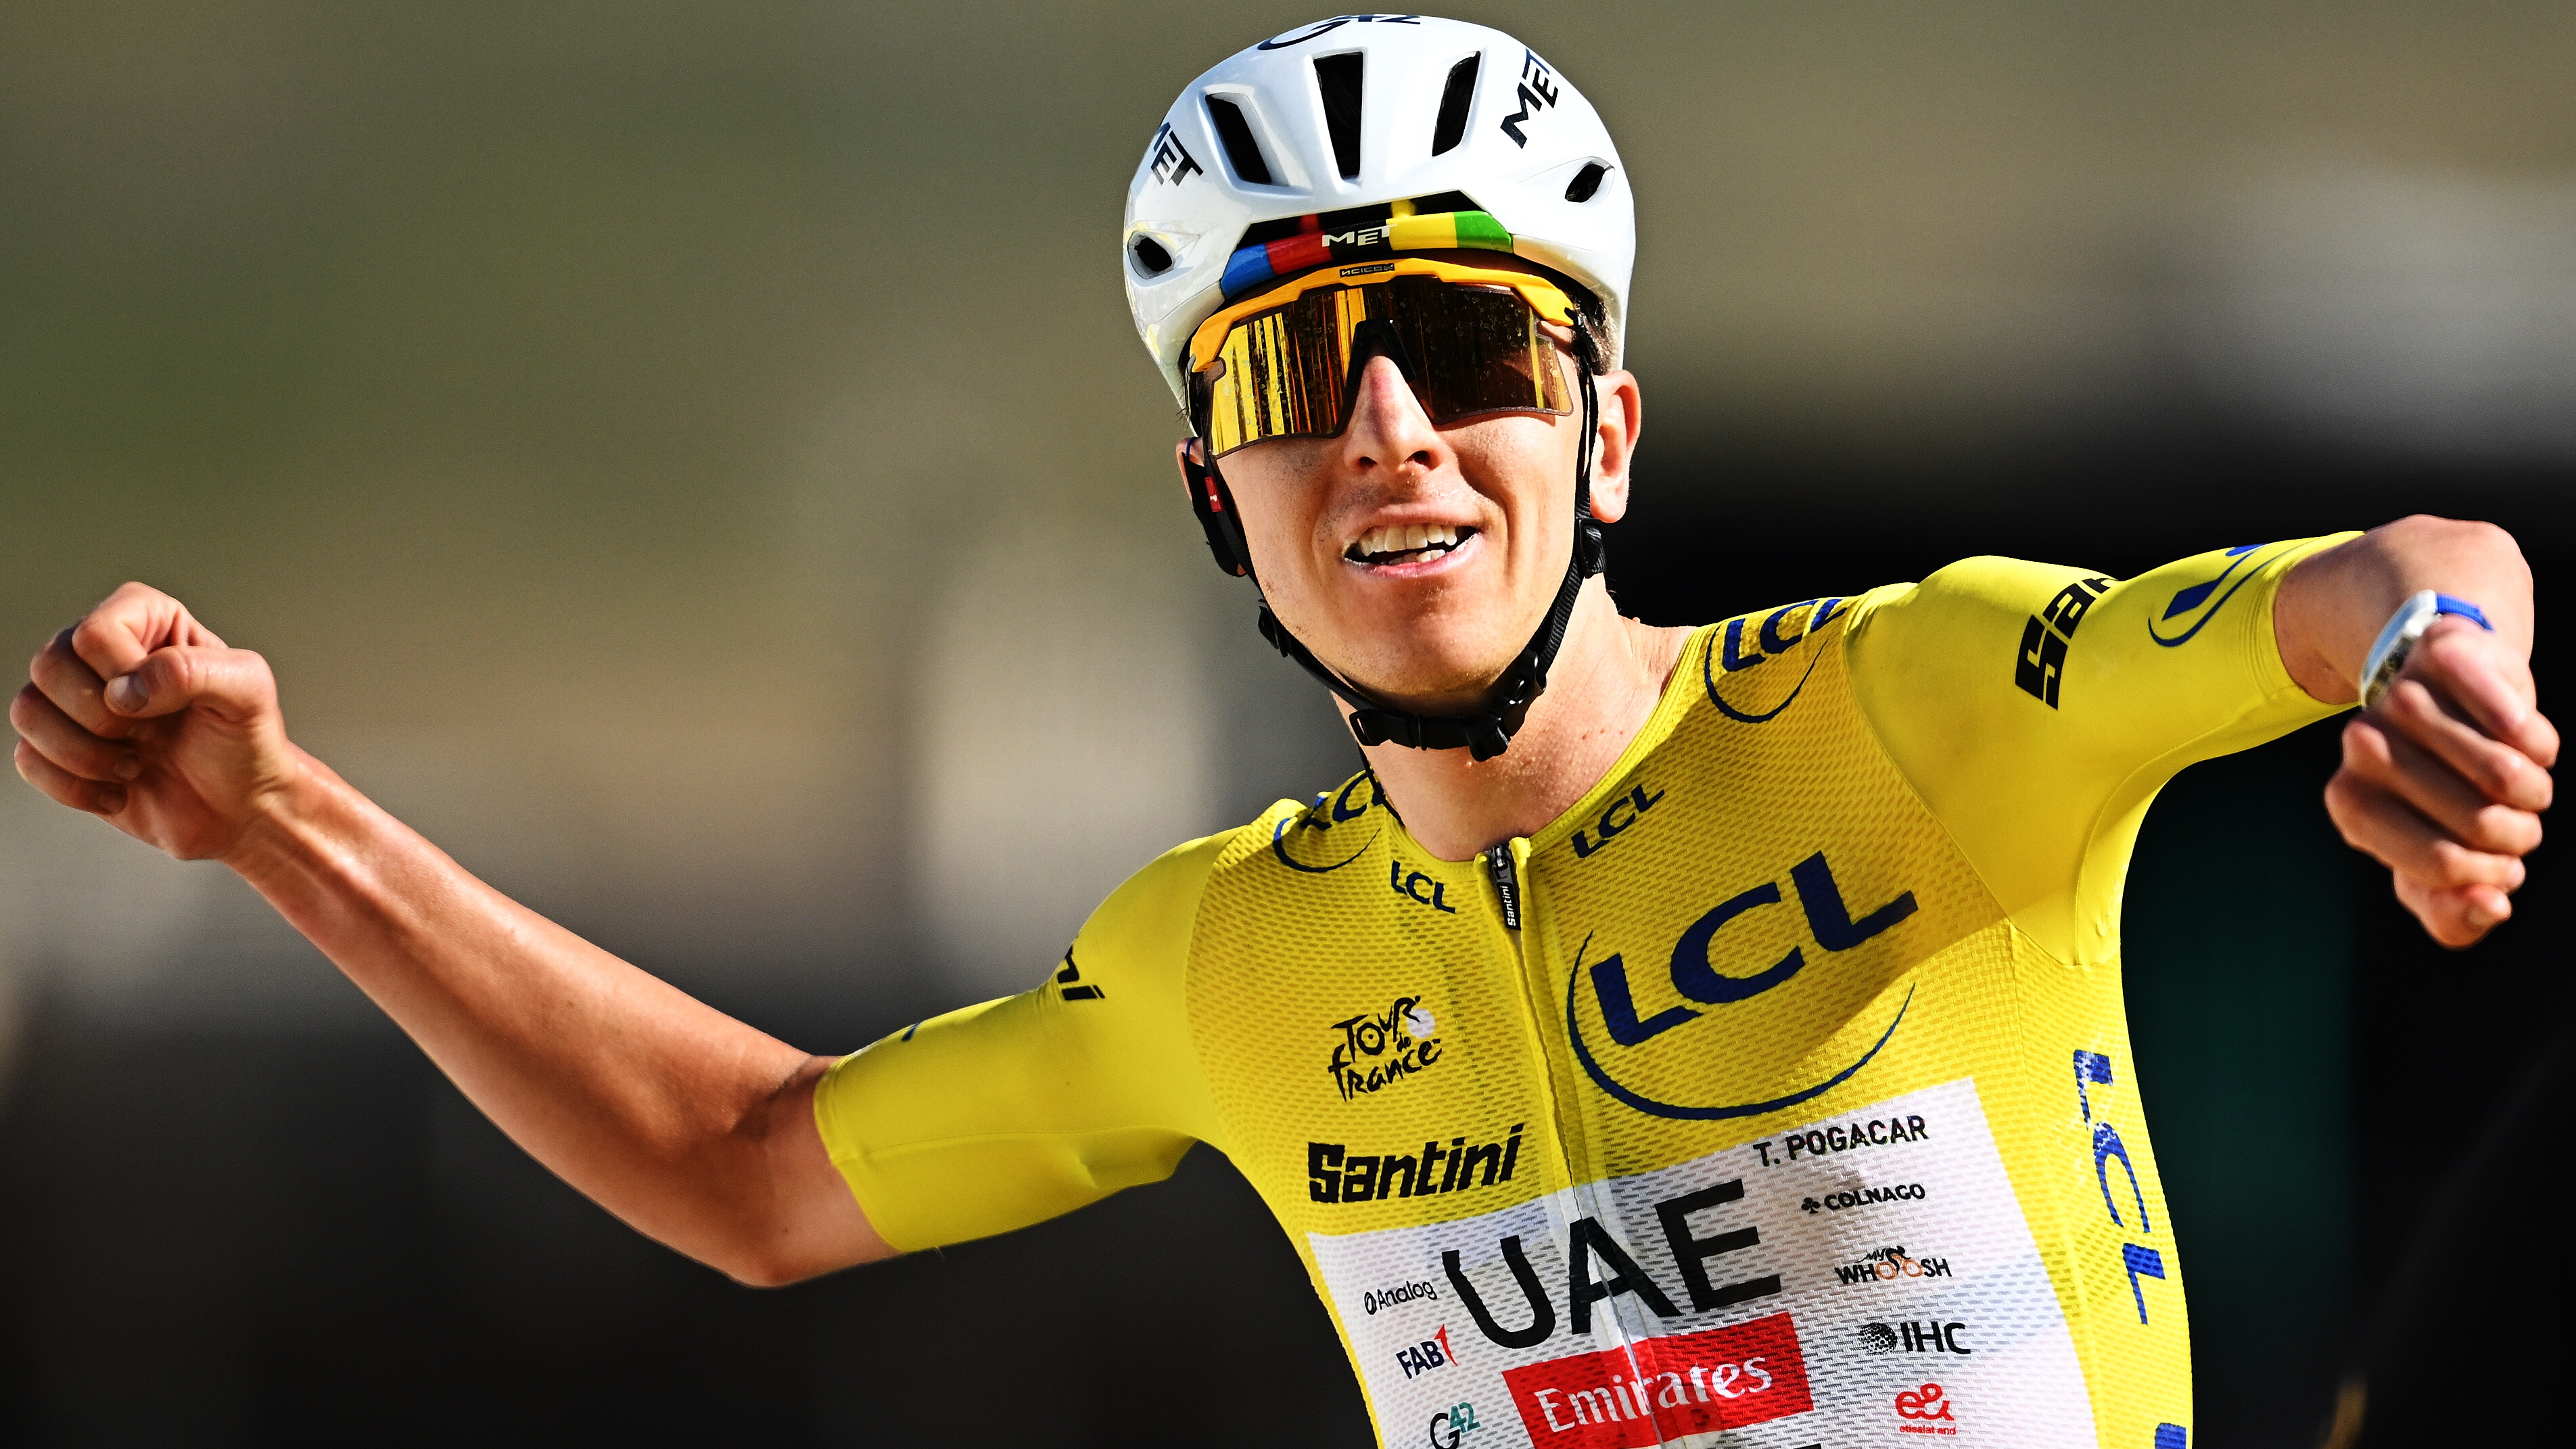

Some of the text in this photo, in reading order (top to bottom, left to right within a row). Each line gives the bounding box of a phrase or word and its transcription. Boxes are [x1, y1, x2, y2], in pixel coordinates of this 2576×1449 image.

[1500, 47, 1559, 149] MET
[1321, 223, 1397, 247] MET
[1723, 598, 1848, 672] LCL
[1571, 784, 1665, 859] LCL
[1391, 859, 1455, 914] LCL
[1499, 885, 1516, 926] Santini
[1589, 850, 1919, 1047] LCL
[1397, 1032, 1411, 1052] de
[1308, 1123, 1525, 1203] Santini
[1753, 1115, 1929, 1167] T. POGACAR
[1824, 1184, 1926, 1210] COLNAGO
[2073, 1049, 2165, 1324] LCL
[1442, 1179, 1781, 1349] UAE
[1834, 1256, 1952, 1285] WHOOSH
[1377, 1281, 1438, 1310] Analog
[1395, 1341, 1445, 1379] FAB
[1900, 1321, 1971, 1355] IHC
[1534, 1356, 1773, 1433] Emirates
[1430, 1402, 1481, 1449] G42
[1899, 1425, 1957, 1435] etisalat and
